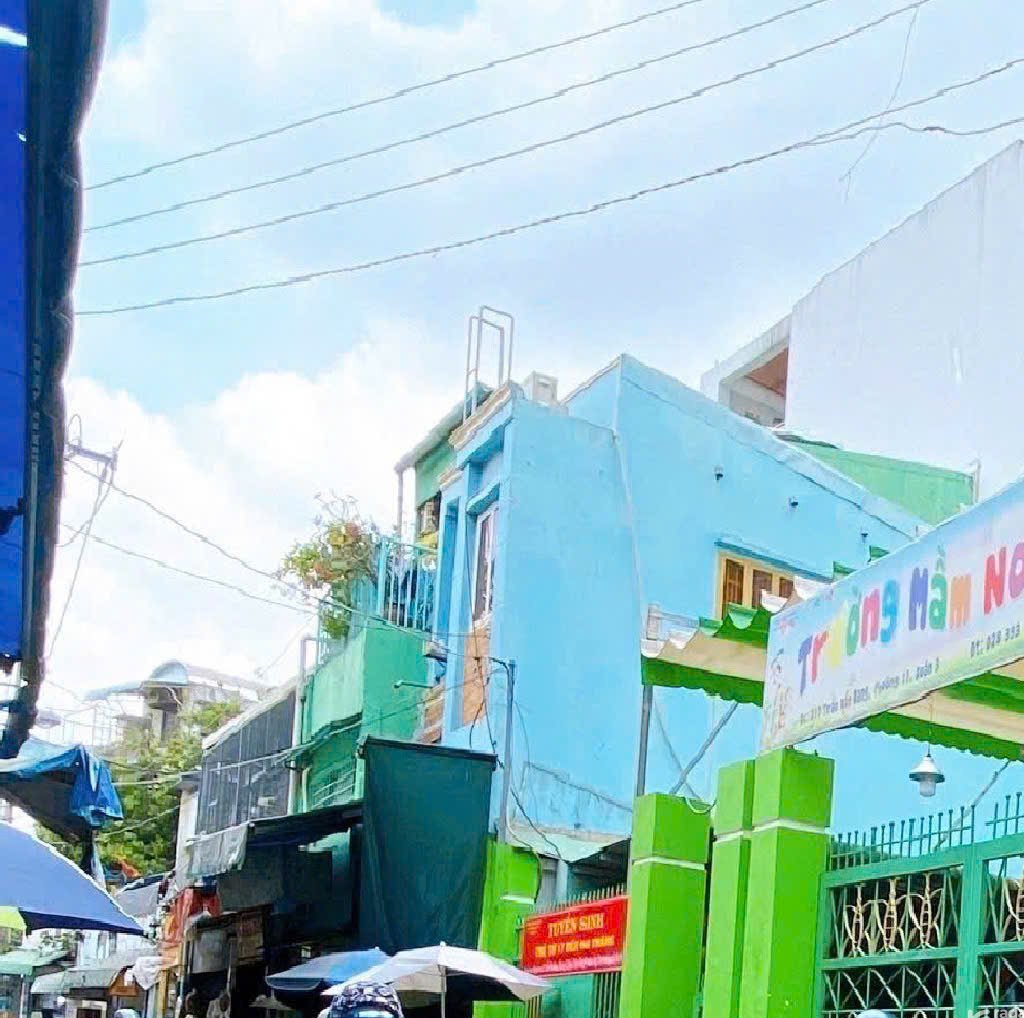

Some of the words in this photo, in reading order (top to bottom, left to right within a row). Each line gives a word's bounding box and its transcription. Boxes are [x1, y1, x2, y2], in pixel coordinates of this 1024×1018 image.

[798, 580, 899, 696] Trường
[908, 545, 971, 631] Mầm
[579, 911, 604, 931] SINH
